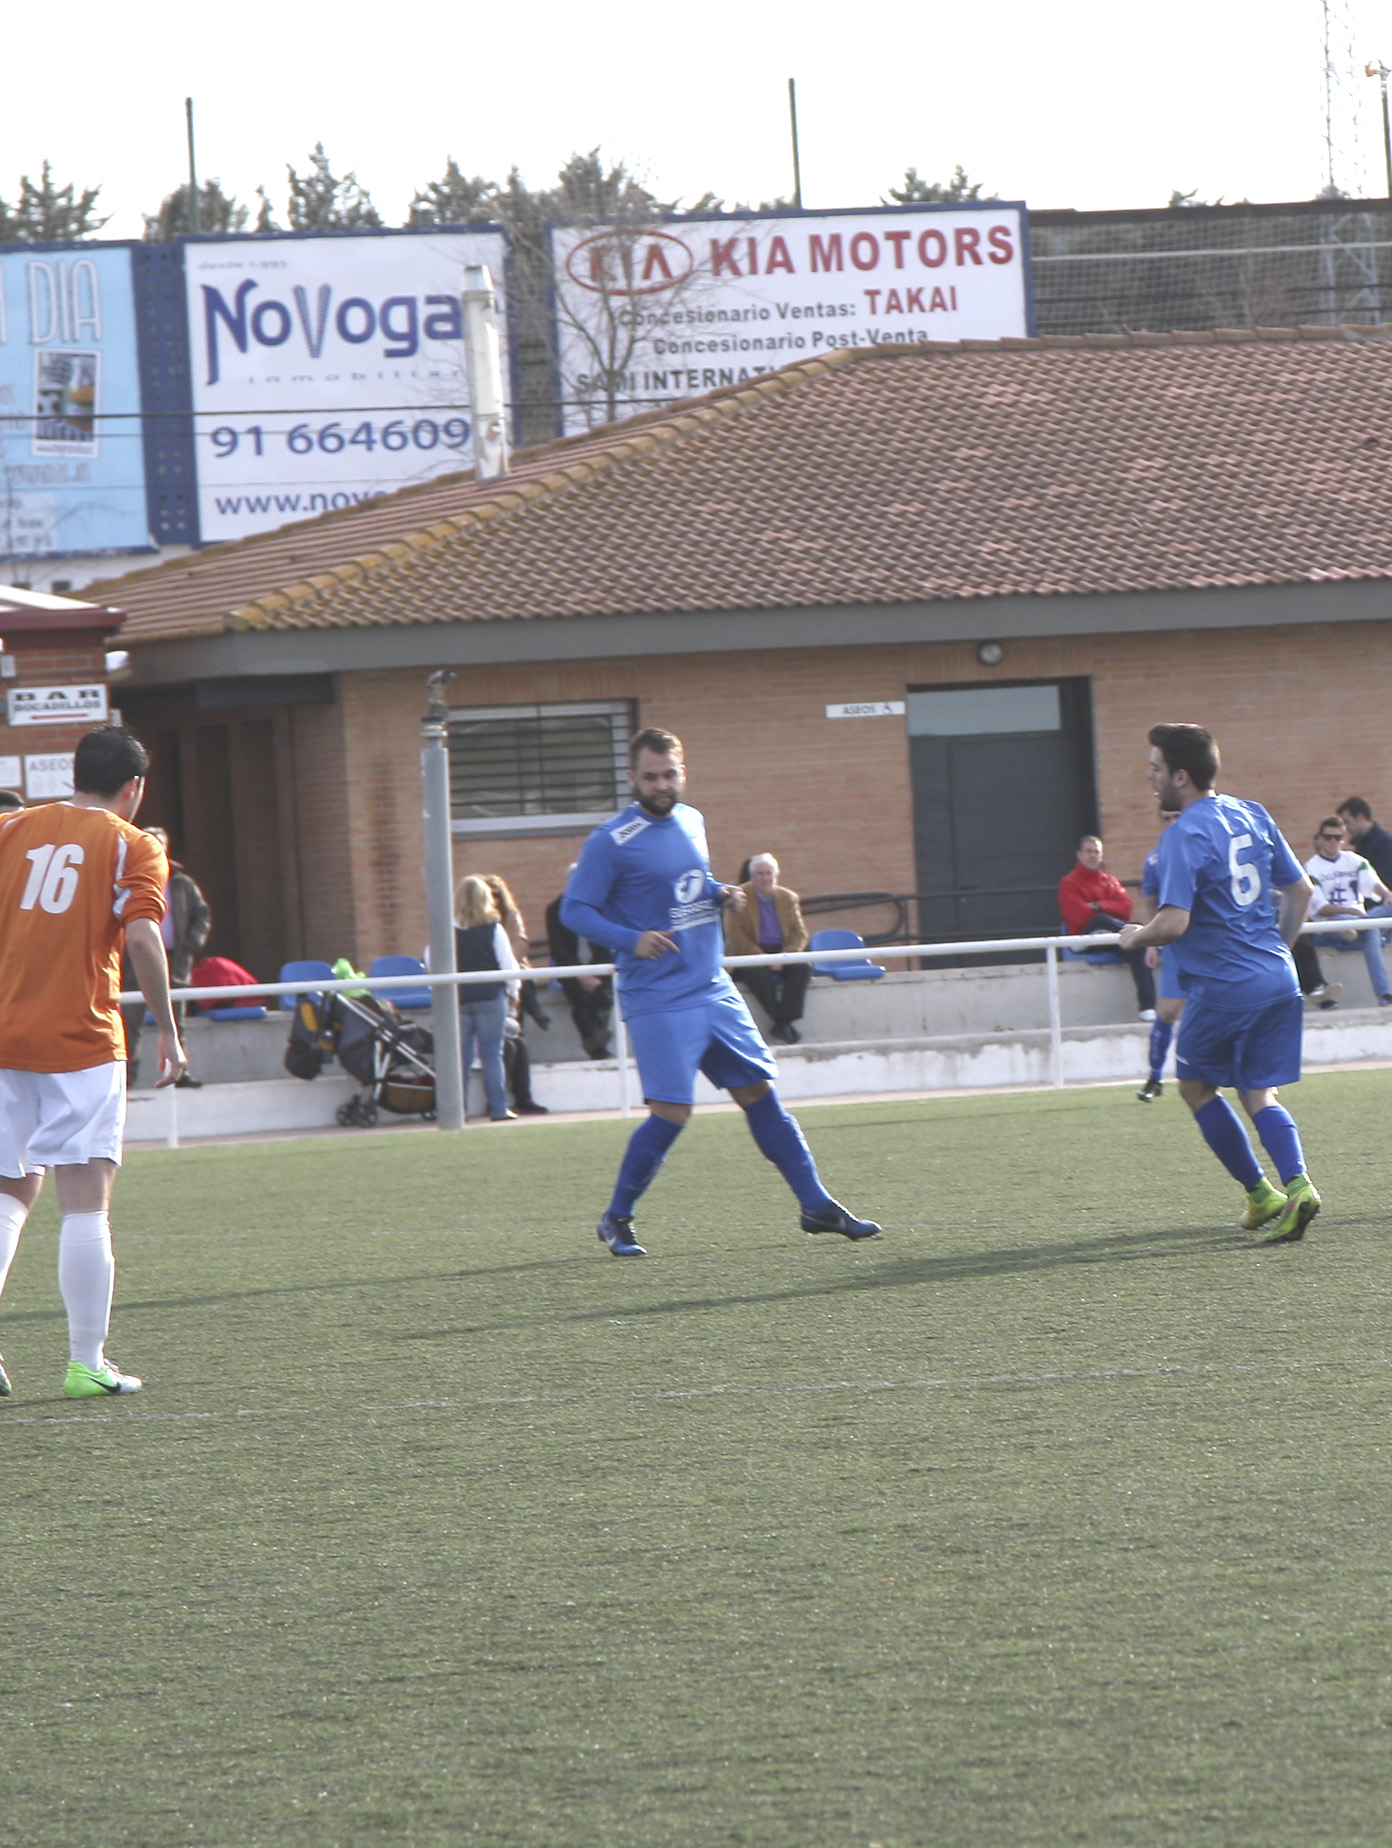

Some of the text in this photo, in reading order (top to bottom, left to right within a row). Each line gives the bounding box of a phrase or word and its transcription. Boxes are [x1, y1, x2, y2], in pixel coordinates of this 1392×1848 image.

[709, 225, 1014, 277] KIA MOTORS
[27, 259, 103, 344] DIA
[618, 285, 958, 326] Concesionario Ventas: TAKAI
[200, 278, 463, 386] NoVoga
[653, 328, 928, 355] Concesionario Post-Venta
[210, 417, 470, 458] 91 664609
[215, 490, 387, 515] www.nov
[16, 690, 100, 701] BAR
[29, 759, 74, 771] ASEO
[20, 843, 85, 914] 16
[1228, 833, 1261, 907] 6
